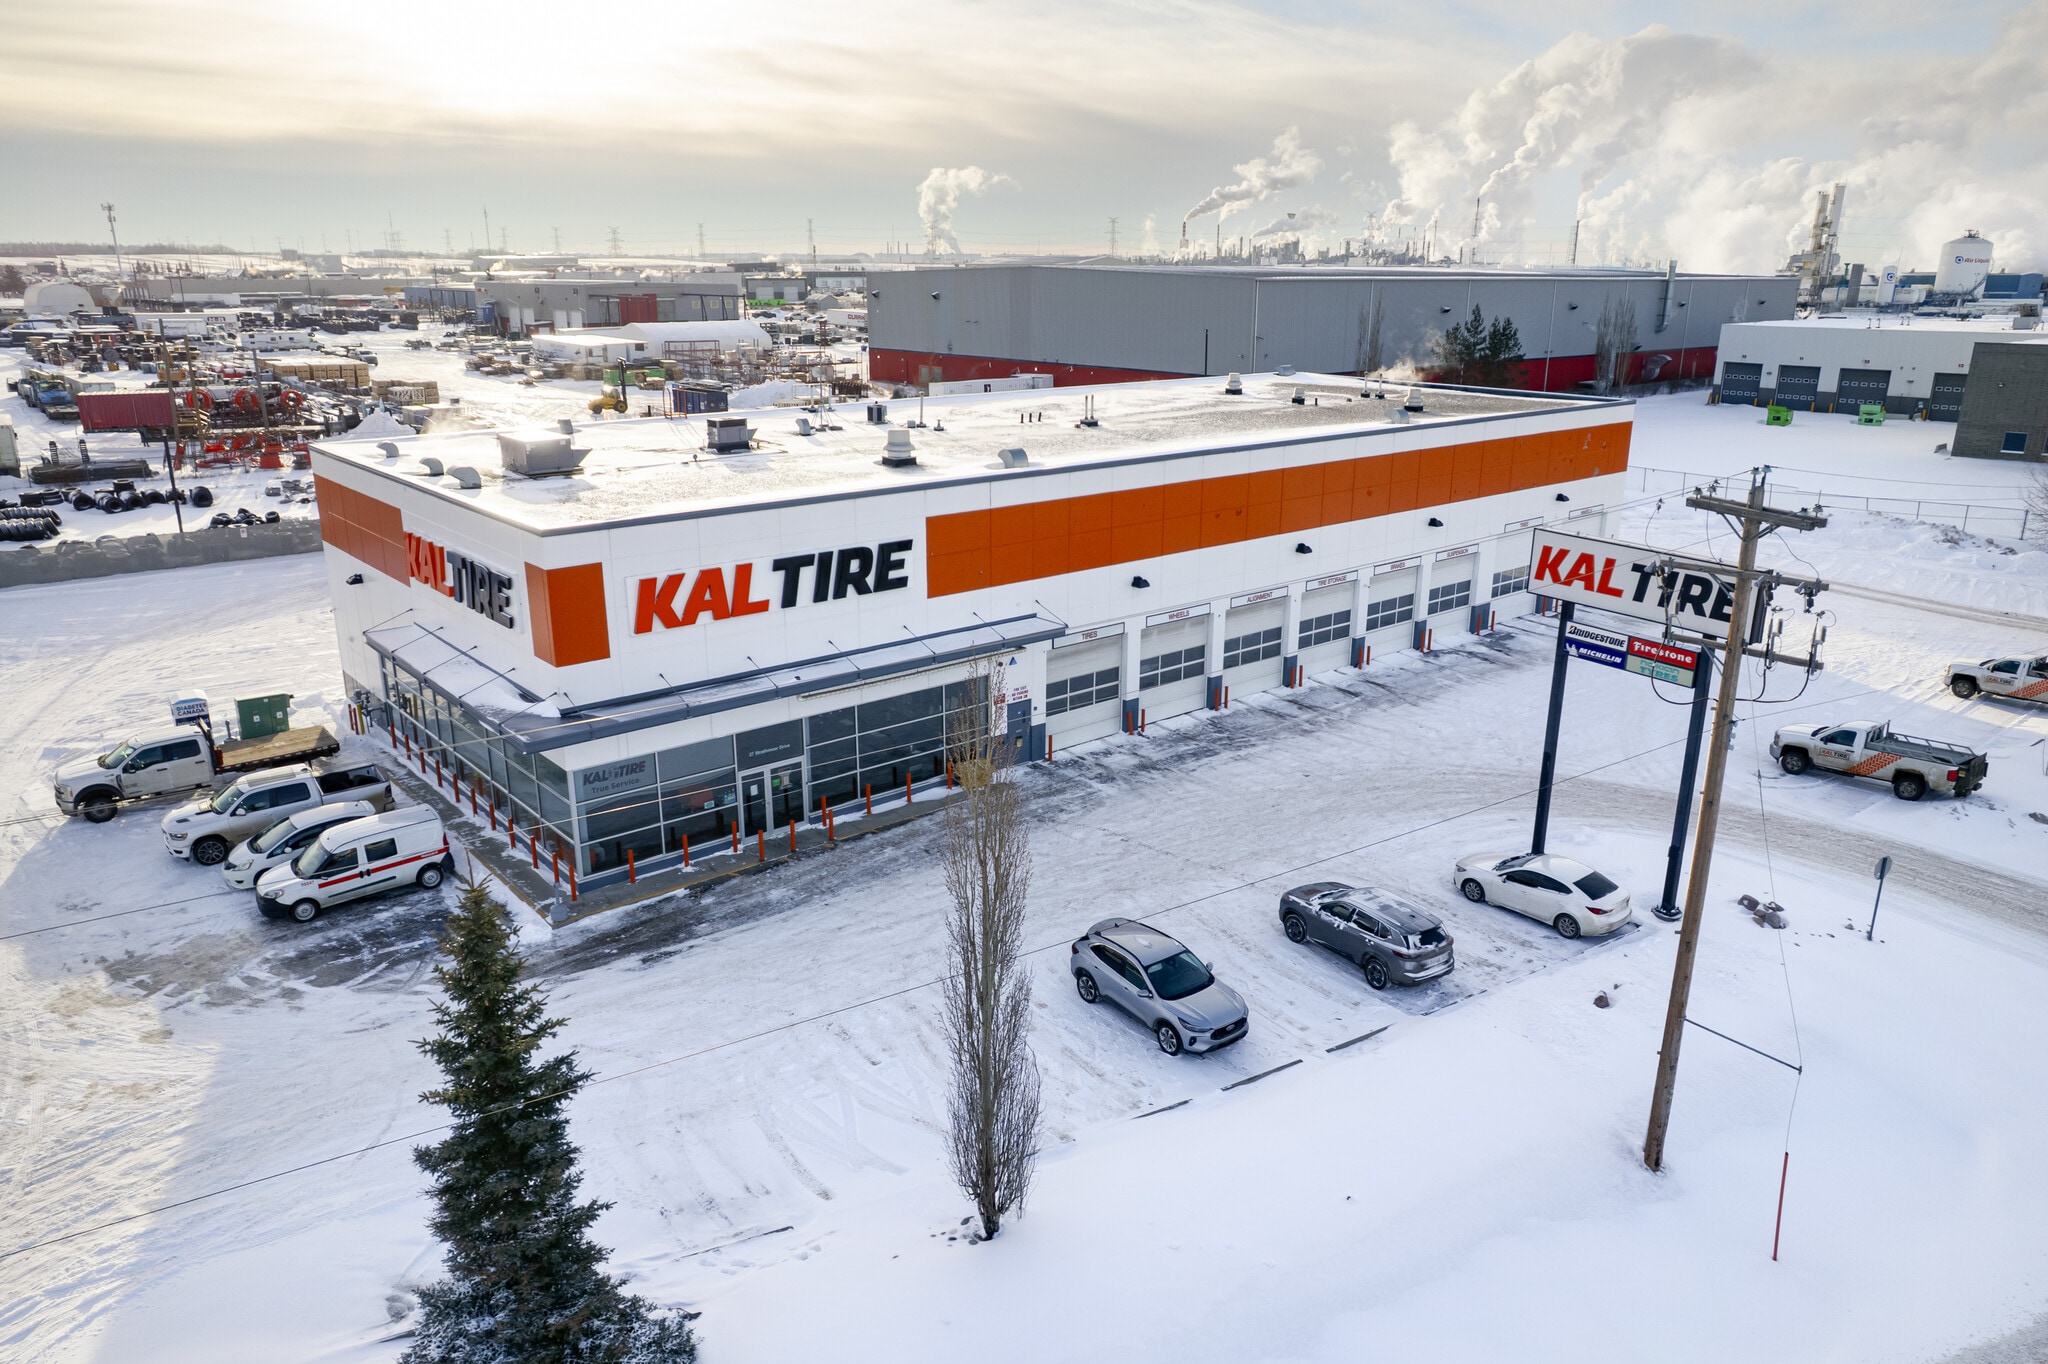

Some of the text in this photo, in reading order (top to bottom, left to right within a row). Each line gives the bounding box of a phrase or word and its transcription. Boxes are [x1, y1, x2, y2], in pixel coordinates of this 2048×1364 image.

[403, 531, 514, 630] KAL TIRE
[634, 538, 914, 635] KAL TIRE
[1318, 575, 1348, 587] TIRE STORAGE
[1534, 544, 1737, 622] KAL TIRE
[1247, 591, 1273, 603] ALIGNMENT
[1168, 609, 1190, 620] WHEELS
[1081, 630, 1098, 641] TIRES
[1567, 624, 1627, 649] BRIDGESTONE
[1578, 646, 1623, 664] MICHELIN
[1633, 640, 1693, 664] Firestone
[1640, 666, 1679, 683] TYRES
[176, 702, 207, 711] DIABETES
[177, 707, 206, 717] CANADA
[583, 760, 646, 786] KAL TIRE
[591, 777, 640, 794] True Service
